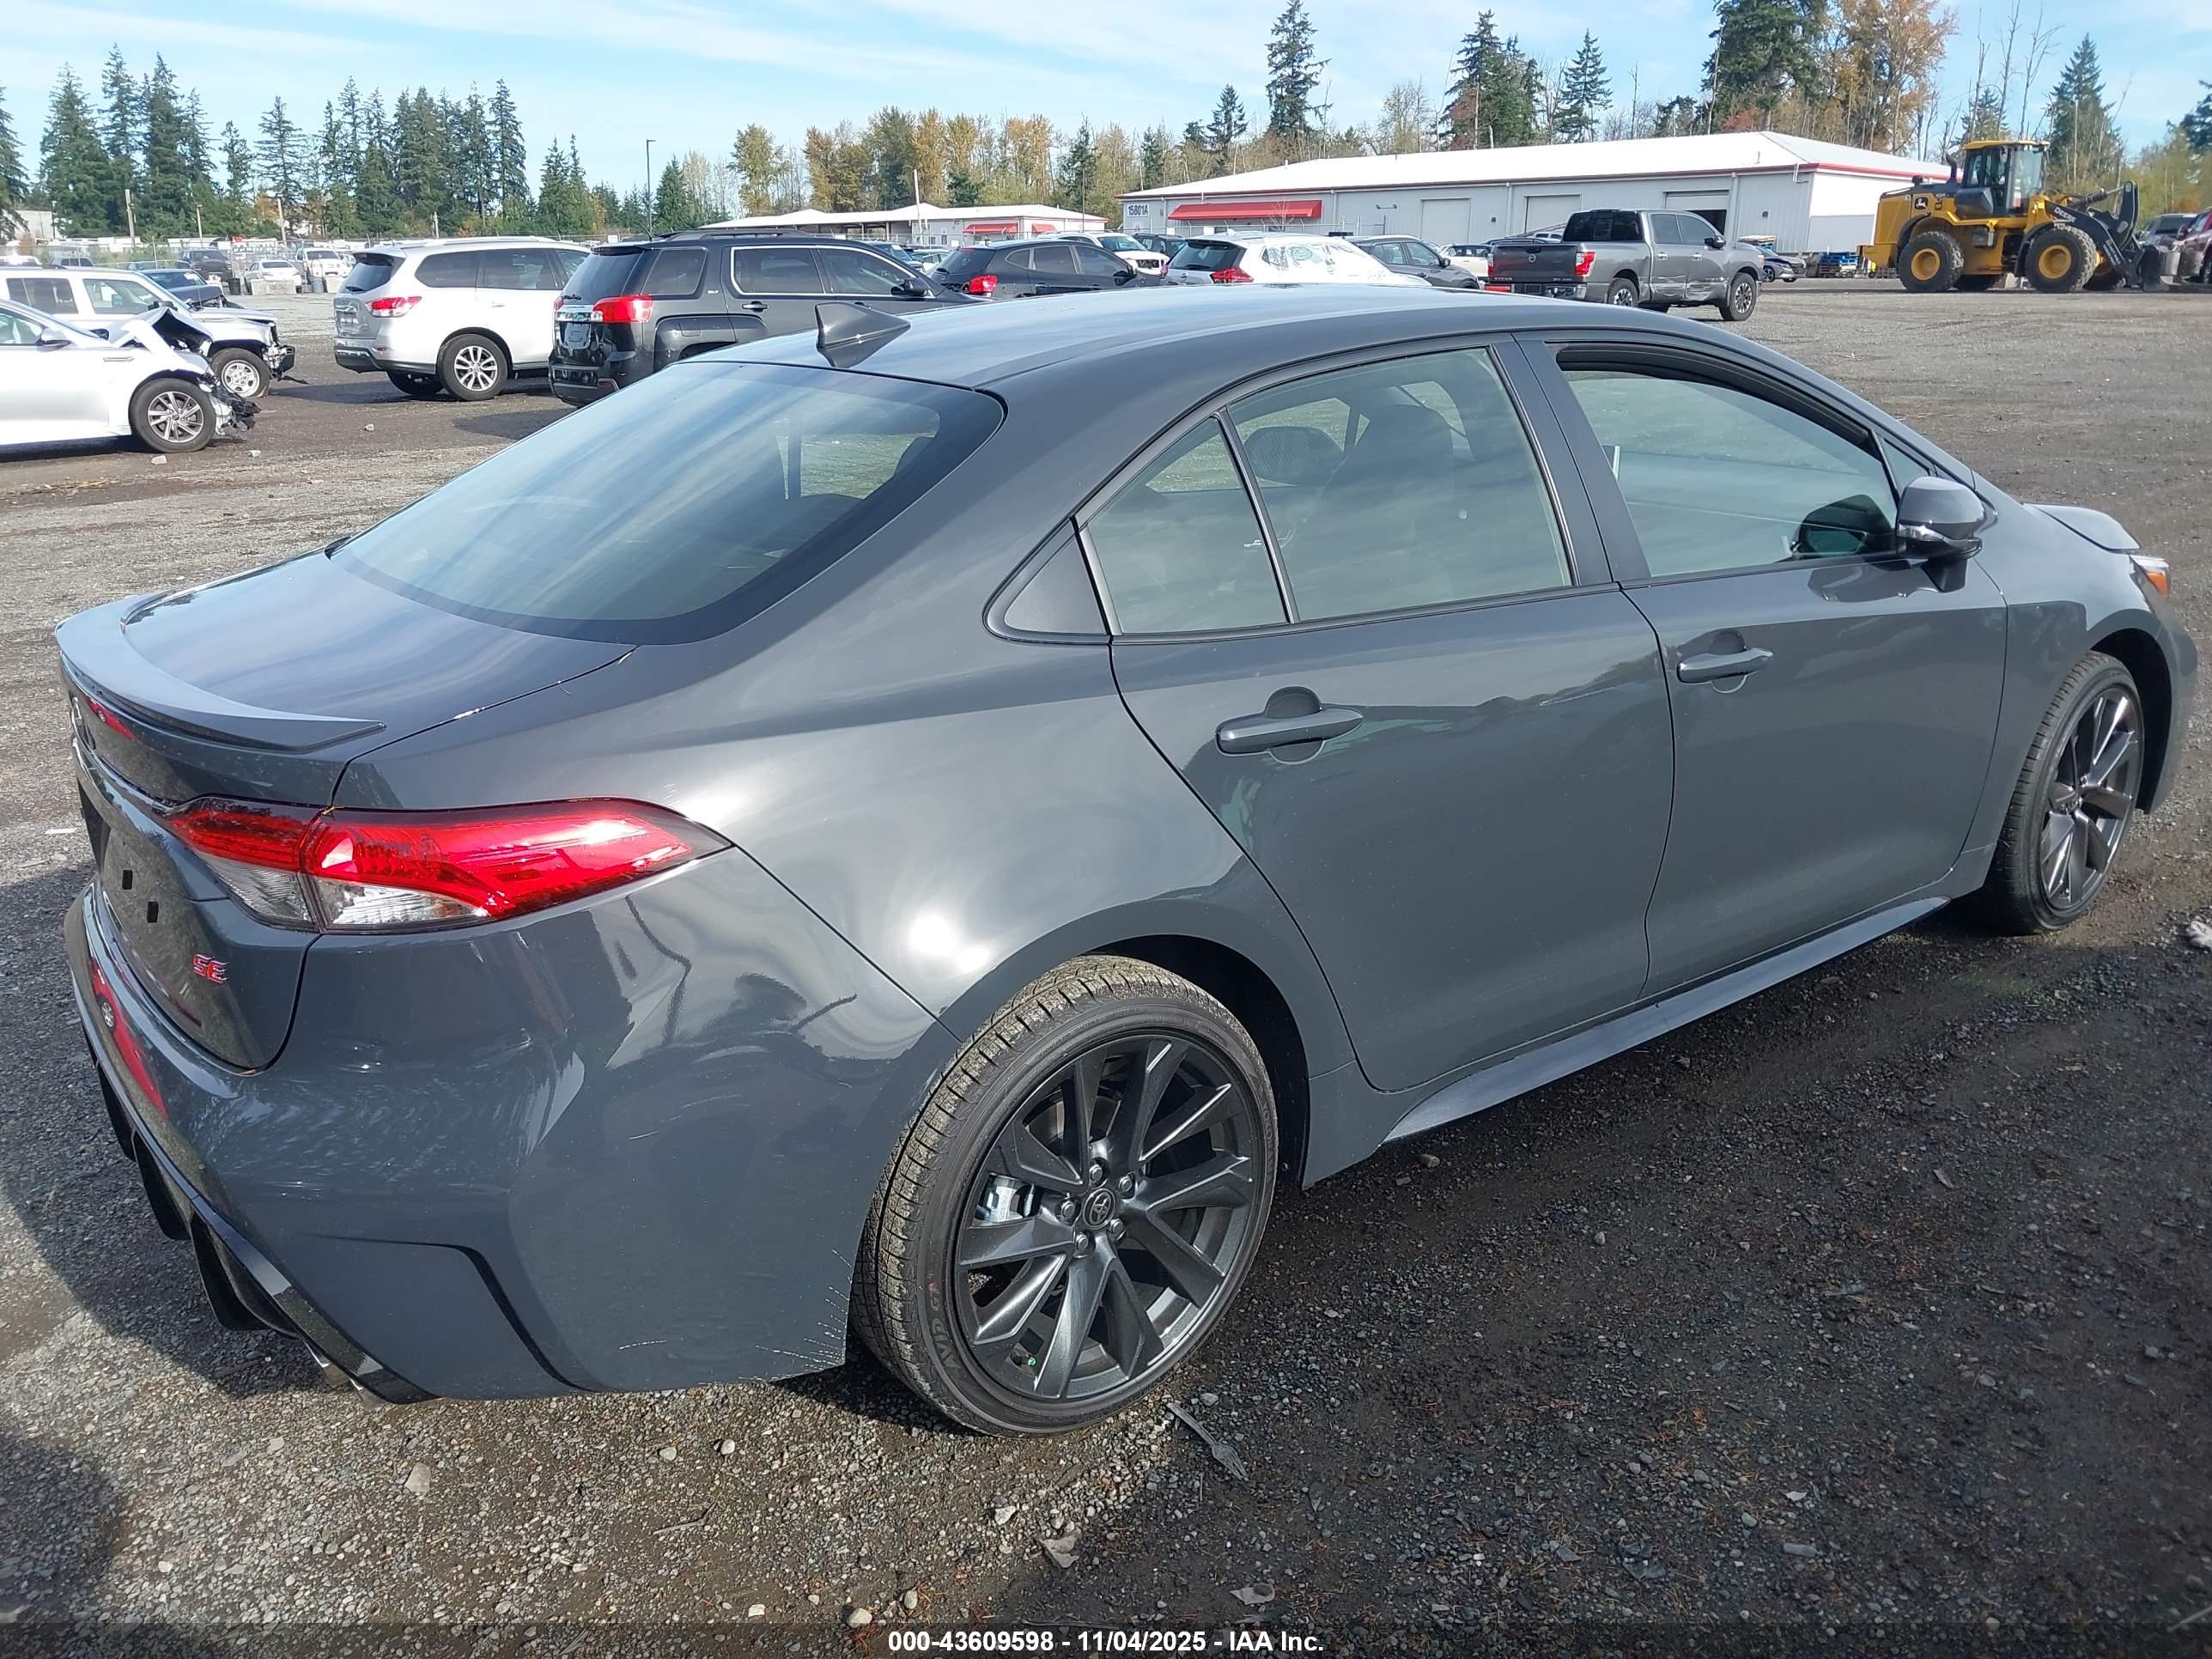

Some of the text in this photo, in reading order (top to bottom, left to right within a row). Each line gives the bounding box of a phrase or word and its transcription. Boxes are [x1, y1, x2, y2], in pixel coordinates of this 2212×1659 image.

[1127, 204, 1148, 216] 15801A
[2054, 207, 2076, 222] DEERE
[193, 954, 228, 984] SE
[932, 1318, 962, 1369] AVID
